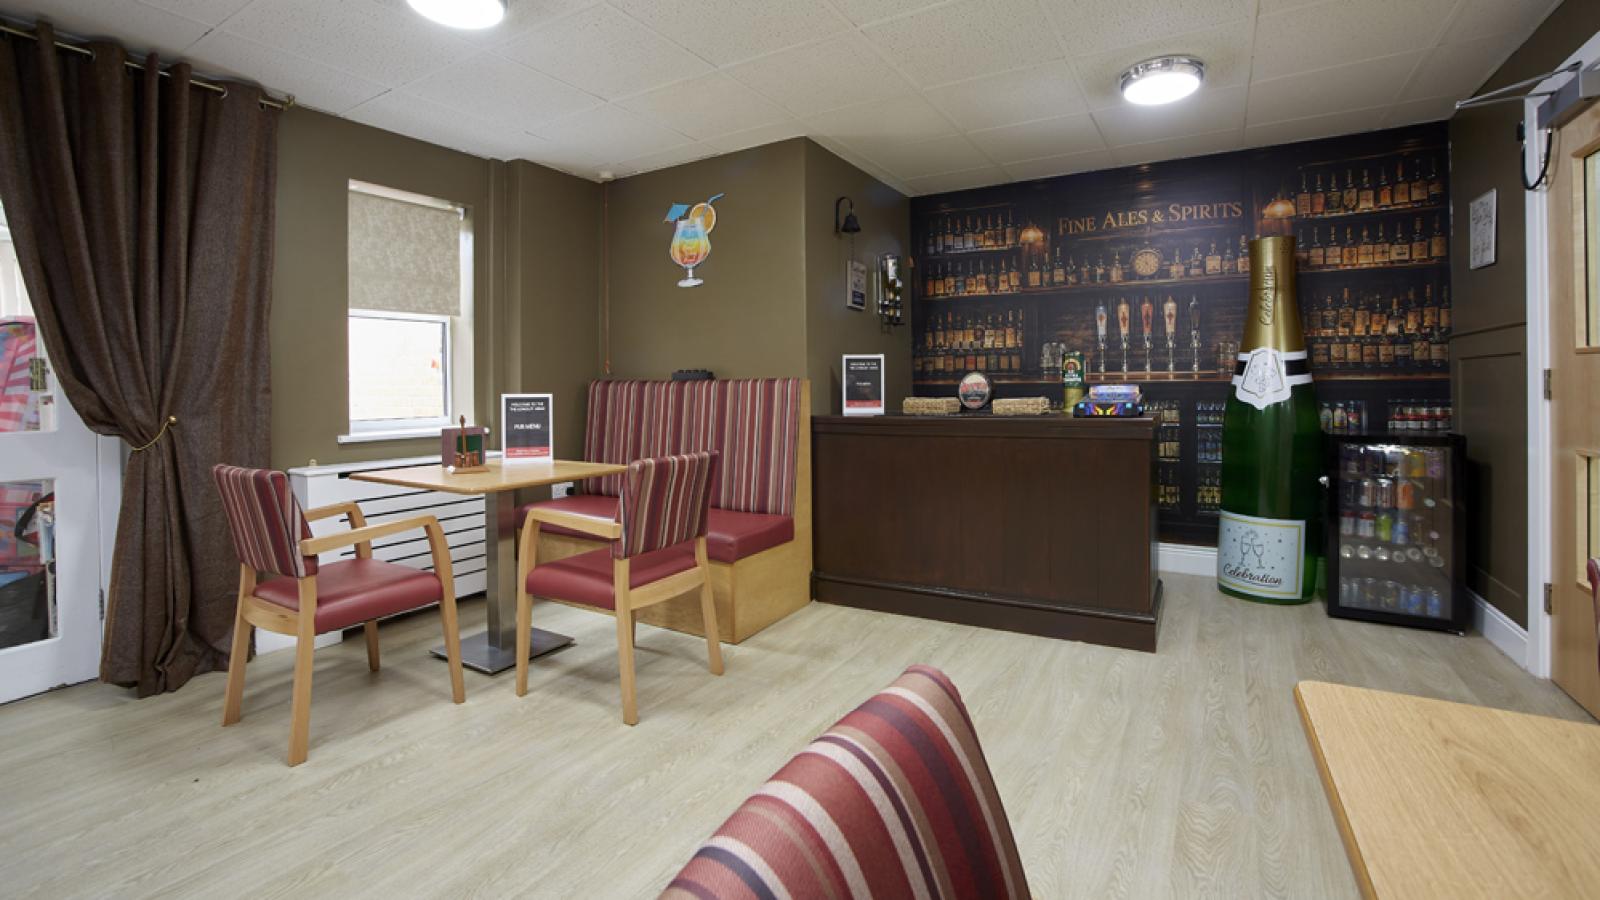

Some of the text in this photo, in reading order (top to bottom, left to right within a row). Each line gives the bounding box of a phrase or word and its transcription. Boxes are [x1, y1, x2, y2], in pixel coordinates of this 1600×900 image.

[1059, 202, 1243, 236] FINE ALES & SPIRITS
[1223, 563, 1282, 585] Celebration
